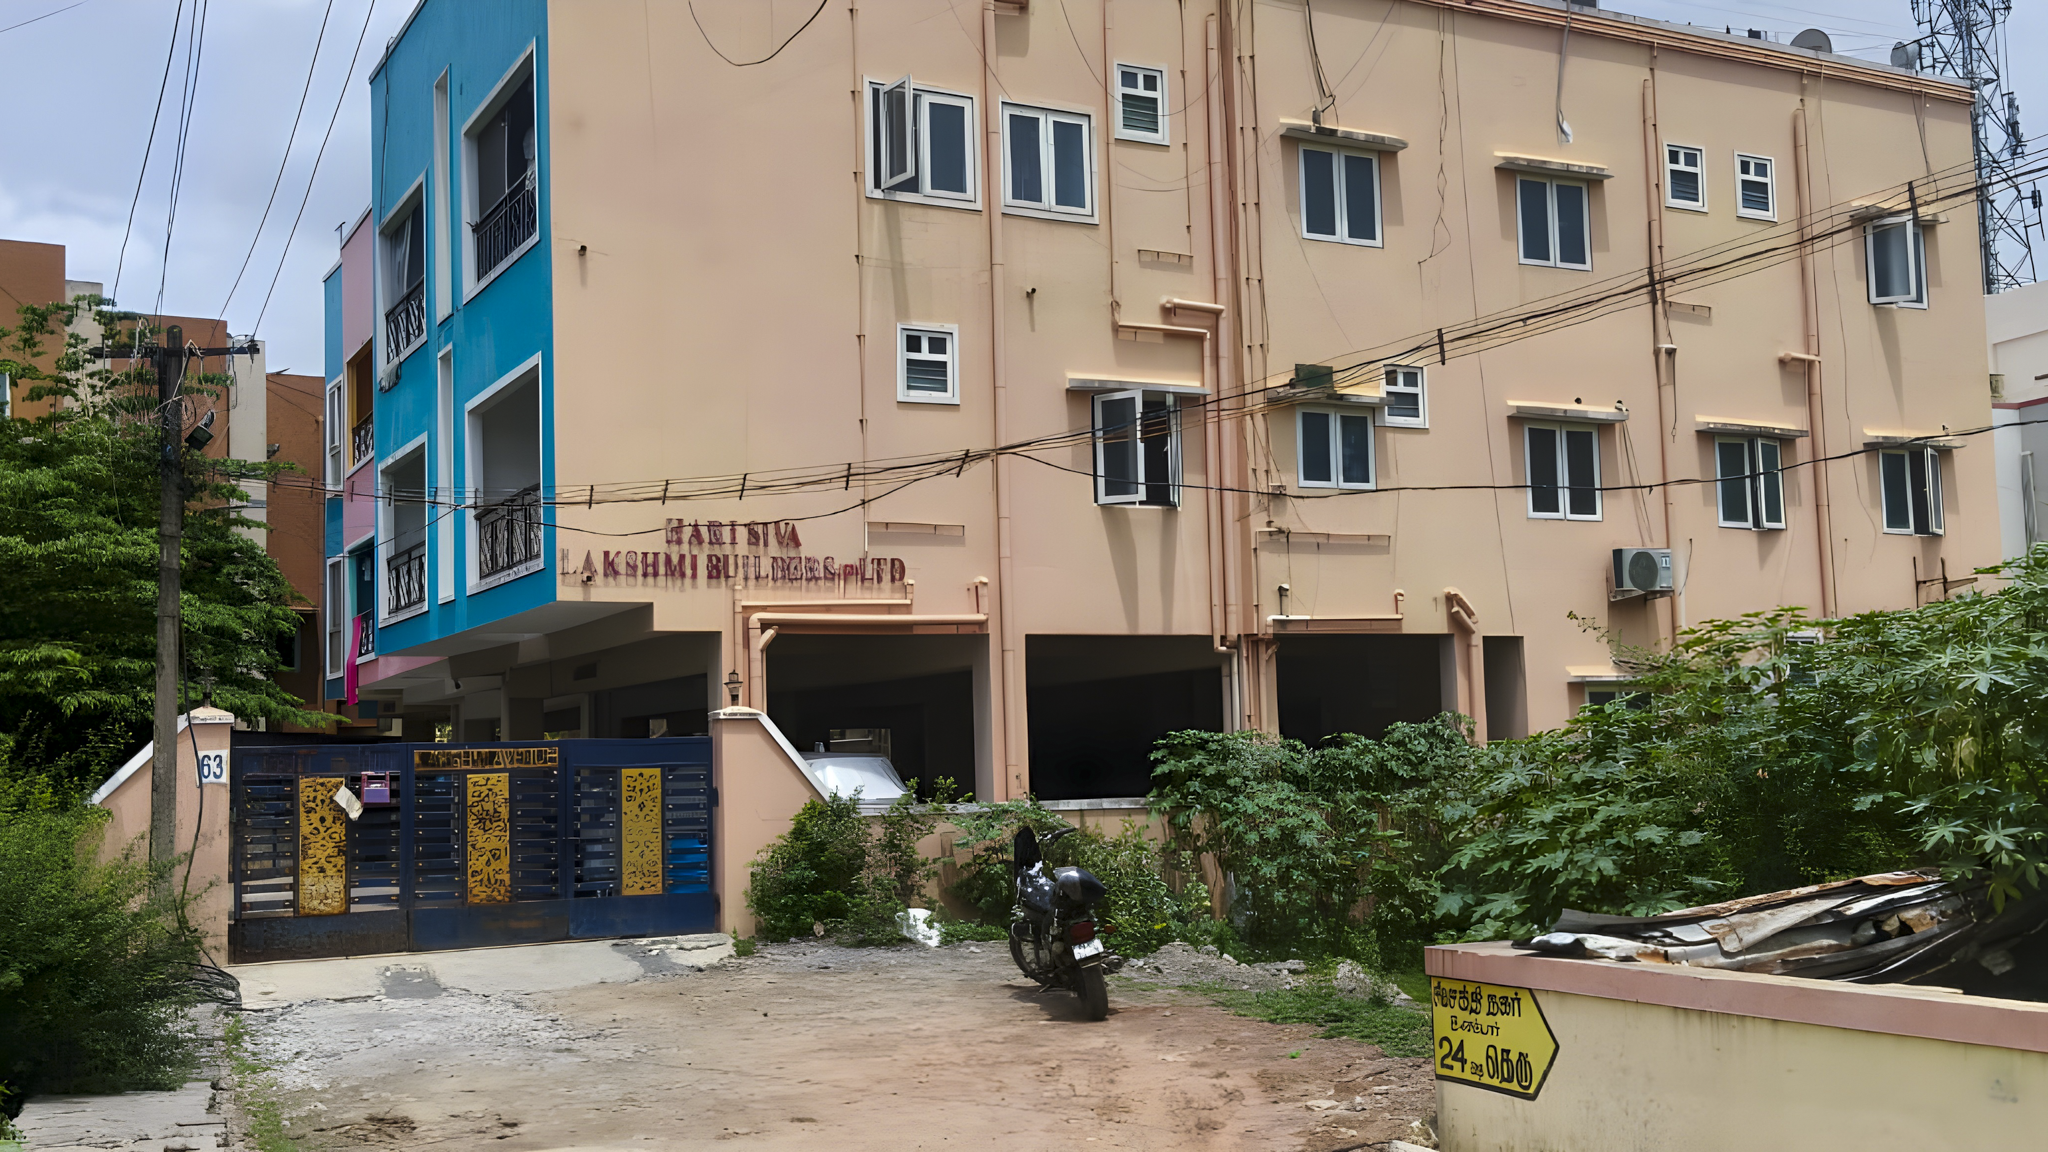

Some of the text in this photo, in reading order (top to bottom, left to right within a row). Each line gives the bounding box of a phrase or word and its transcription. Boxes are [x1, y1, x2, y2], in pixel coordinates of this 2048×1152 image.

[747, 520, 803, 549] SIVA
[560, 548, 698, 580] LAKSHMI
[201, 754, 223, 779] 63
[1486, 991, 1521, 1017] நகர்
[1438, 1036, 1467, 1073] 24
